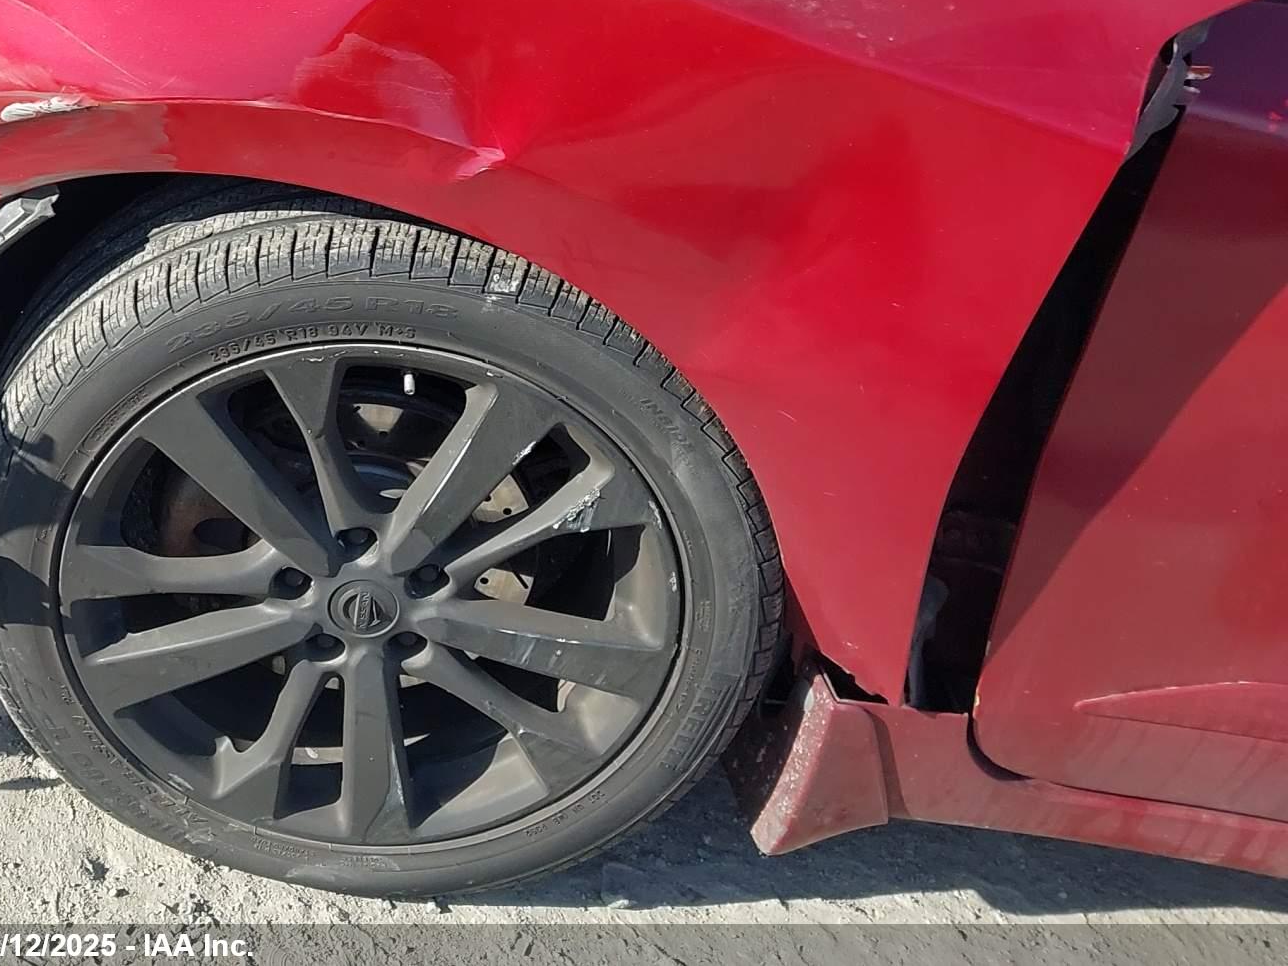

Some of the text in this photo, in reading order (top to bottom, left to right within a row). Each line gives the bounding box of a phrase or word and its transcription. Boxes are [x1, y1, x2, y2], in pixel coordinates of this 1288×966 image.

[166, 296, 460, 353] 235/45 R18
[208, 332, 277, 363] 235/45
[285, 322, 320, 340] R18
[327, 321, 372, 338] 94V
[359, 592, 370, 628] NISSAN
